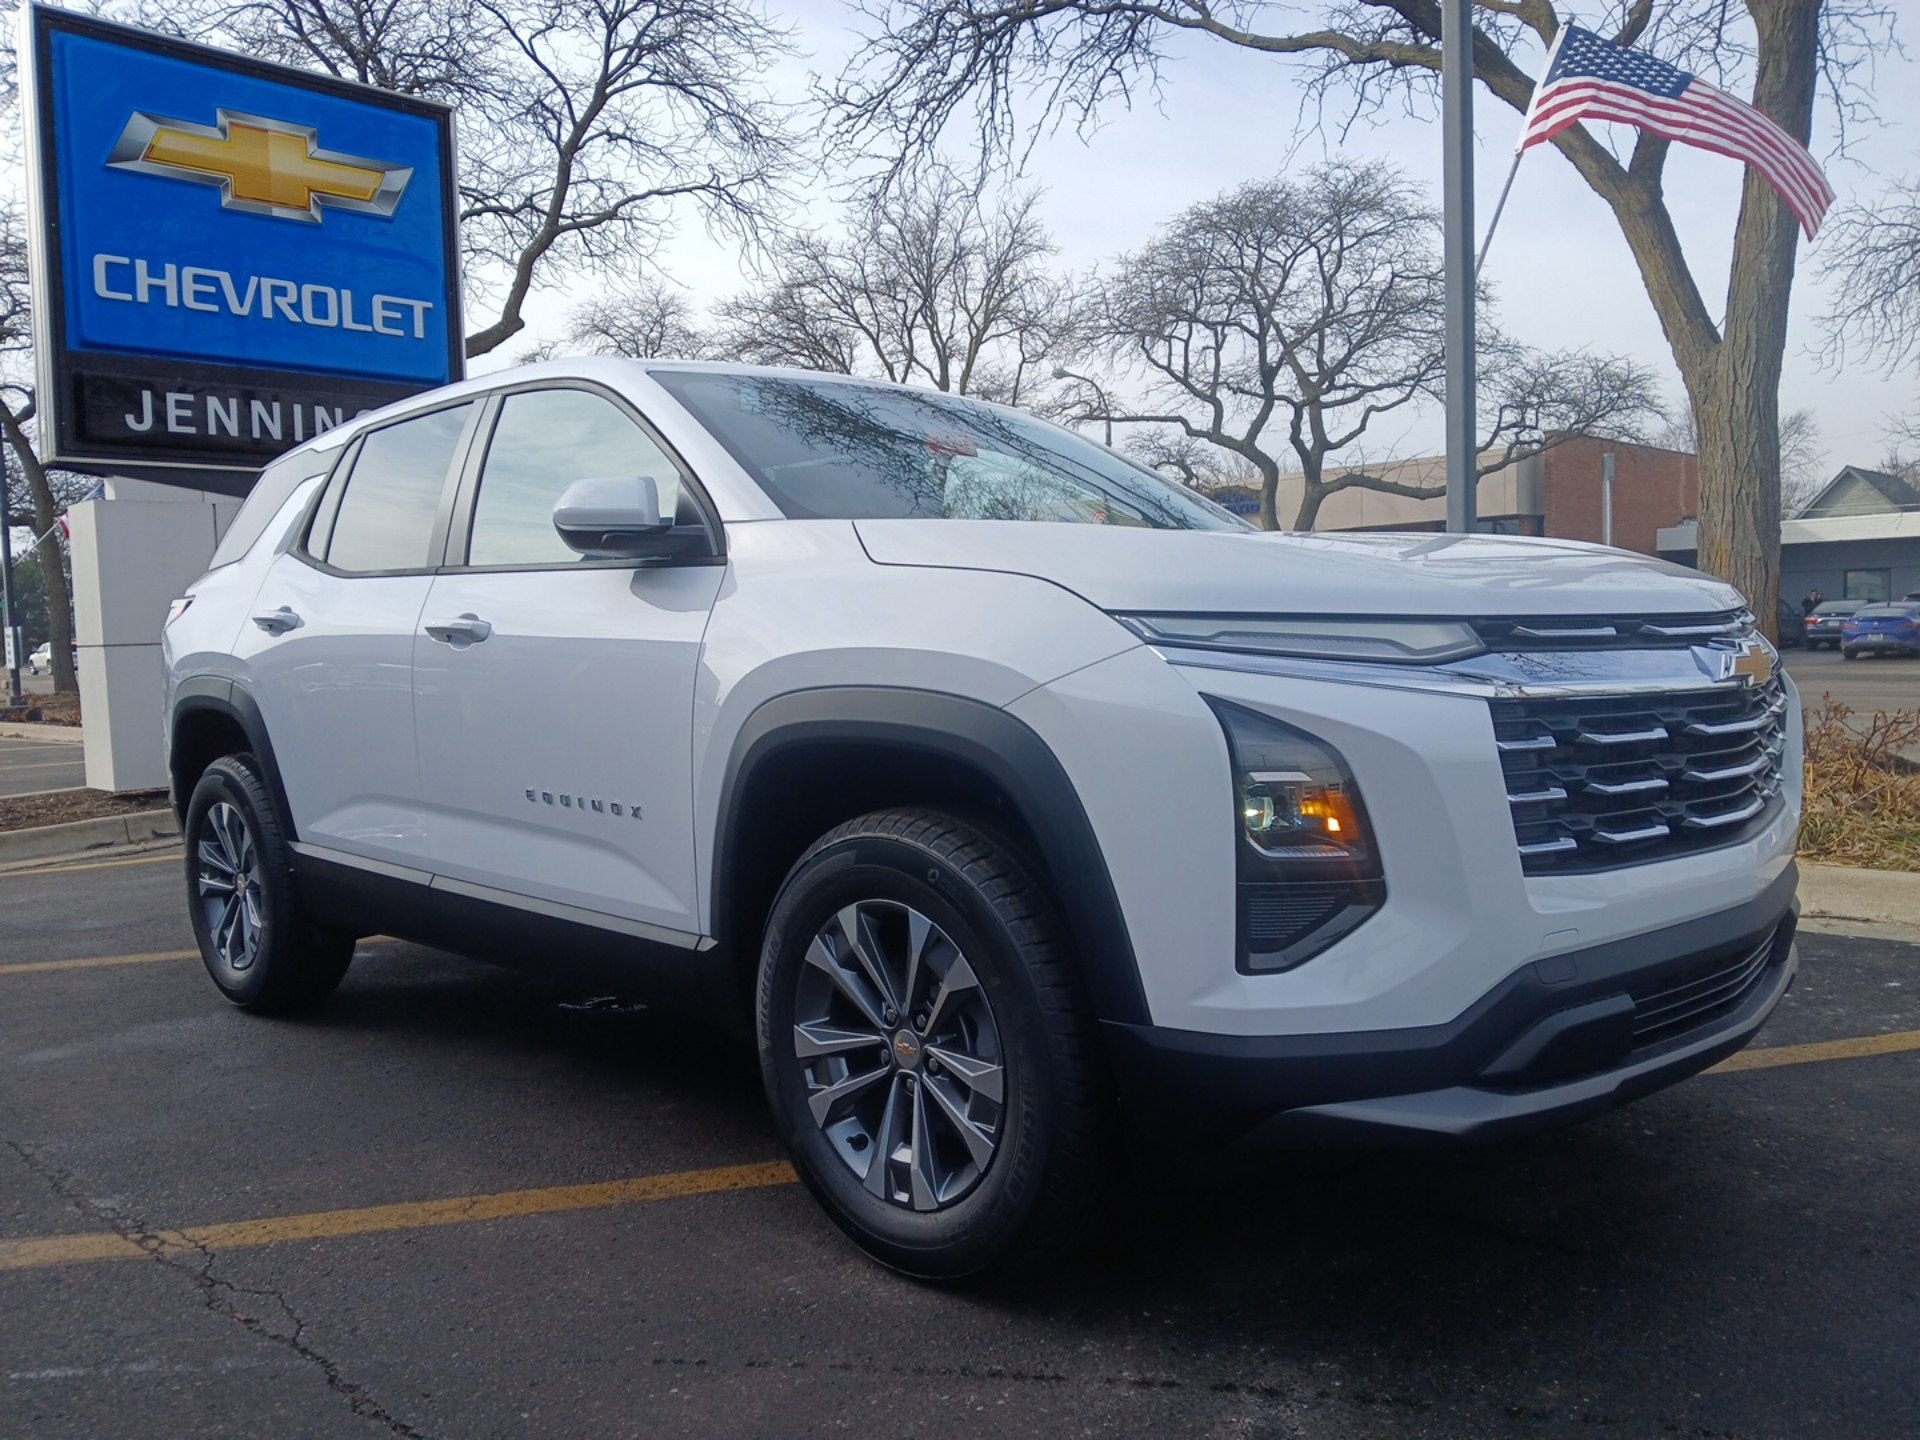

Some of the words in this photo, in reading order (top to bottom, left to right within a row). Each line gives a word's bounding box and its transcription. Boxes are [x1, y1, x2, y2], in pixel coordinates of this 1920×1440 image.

[93, 253, 433, 338] CHEVROLET
[525, 788, 642, 820] EQUINOX
[760, 933, 781, 1041] MICHELIN
